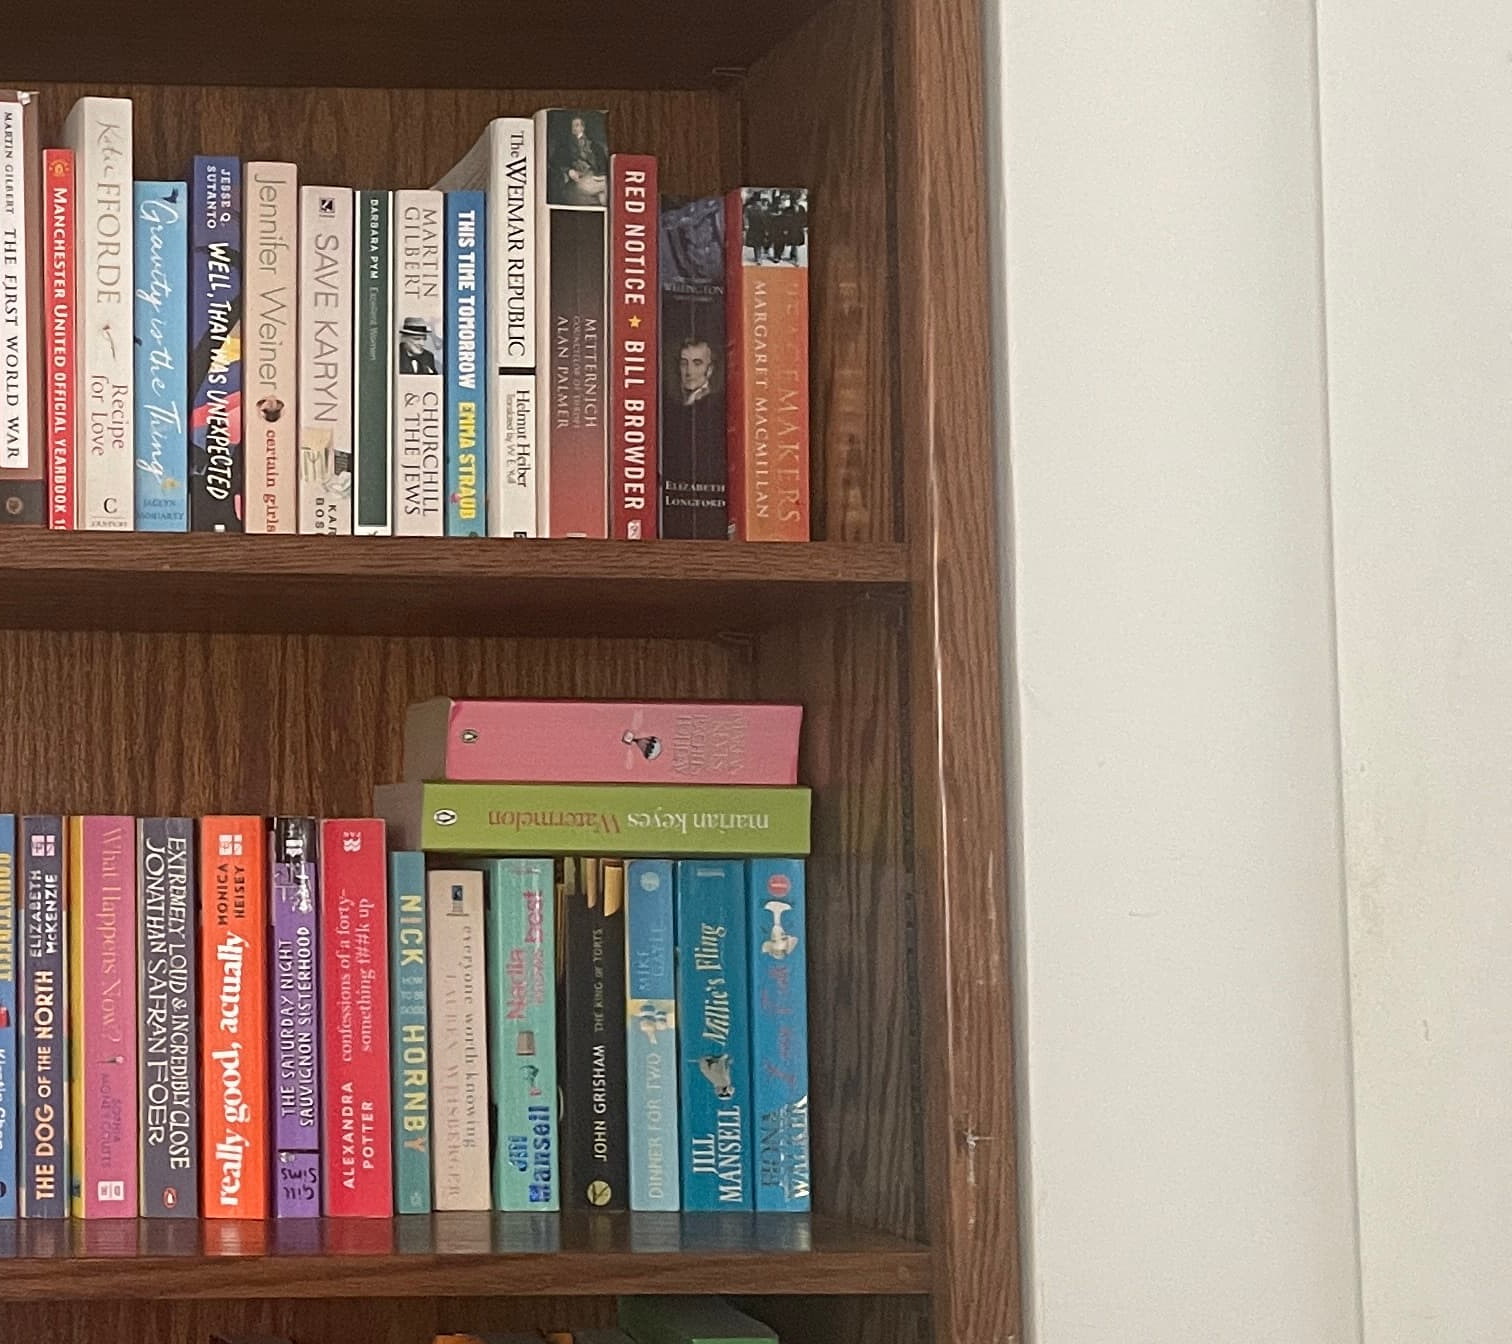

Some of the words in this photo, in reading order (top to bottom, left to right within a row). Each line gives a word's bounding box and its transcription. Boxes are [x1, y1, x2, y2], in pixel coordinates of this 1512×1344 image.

[254, 173, 286, 275] Jennifer
[625, 170, 645, 213] RED
[3, 229, 17, 265] THE
[404, 207, 421, 299] GILBERT
[423, 209, 439, 297] MARTIN
[458, 210, 476, 248] THIS
[625, 224, 645, 305] NOTICE
[1, 273, 18, 327] FIRST
[313, 235, 339, 308] SAVE
[458, 253, 475, 292] TIME
[7, 336, 19, 407] WORLD
[257, 286, 286, 390] Weiner
[313, 320, 339, 421] KARYN
[458, 296, 476, 389] TOMORROW
[625, 341, 644, 389] BILL
[404, 394, 420, 407] &
[404, 412, 421, 455] THE
[7, 415, 20, 460] WAR
[422, 392, 439, 517] CHURCHILL
[625, 403, 644, 510] BROWDER
[401, 464, 421, 515] JEWS
[147, 839, 166, 957] JONATHAN
[400, 895, 423, 968] NICK
[36, 971, 53, 1038] NORTH
[148, 960, 166, 1057] SAFRAN
[216, 932, 248, 1034] actually
[38, 1044, 51, 1069] THE
[38, 1075, 50, 1099] OF
[213, 1041, 249, 1123] good,
[403, 1026, 427, 1152] HORNBY
[594, 1045, 607, 1115] GRISHAM
[36, 1108, 53, 1157] DOG
[147, 1061, 166, 1145] FOER
[342, 1082, 354, 1188] ALEXANDRA
[362, 1101, 373, 1169] POTTER
[216, 1132, 251, 1206] really
[595, 1120, 607, 1162] JOHN
[36, 1165, 54, 1200] THE
